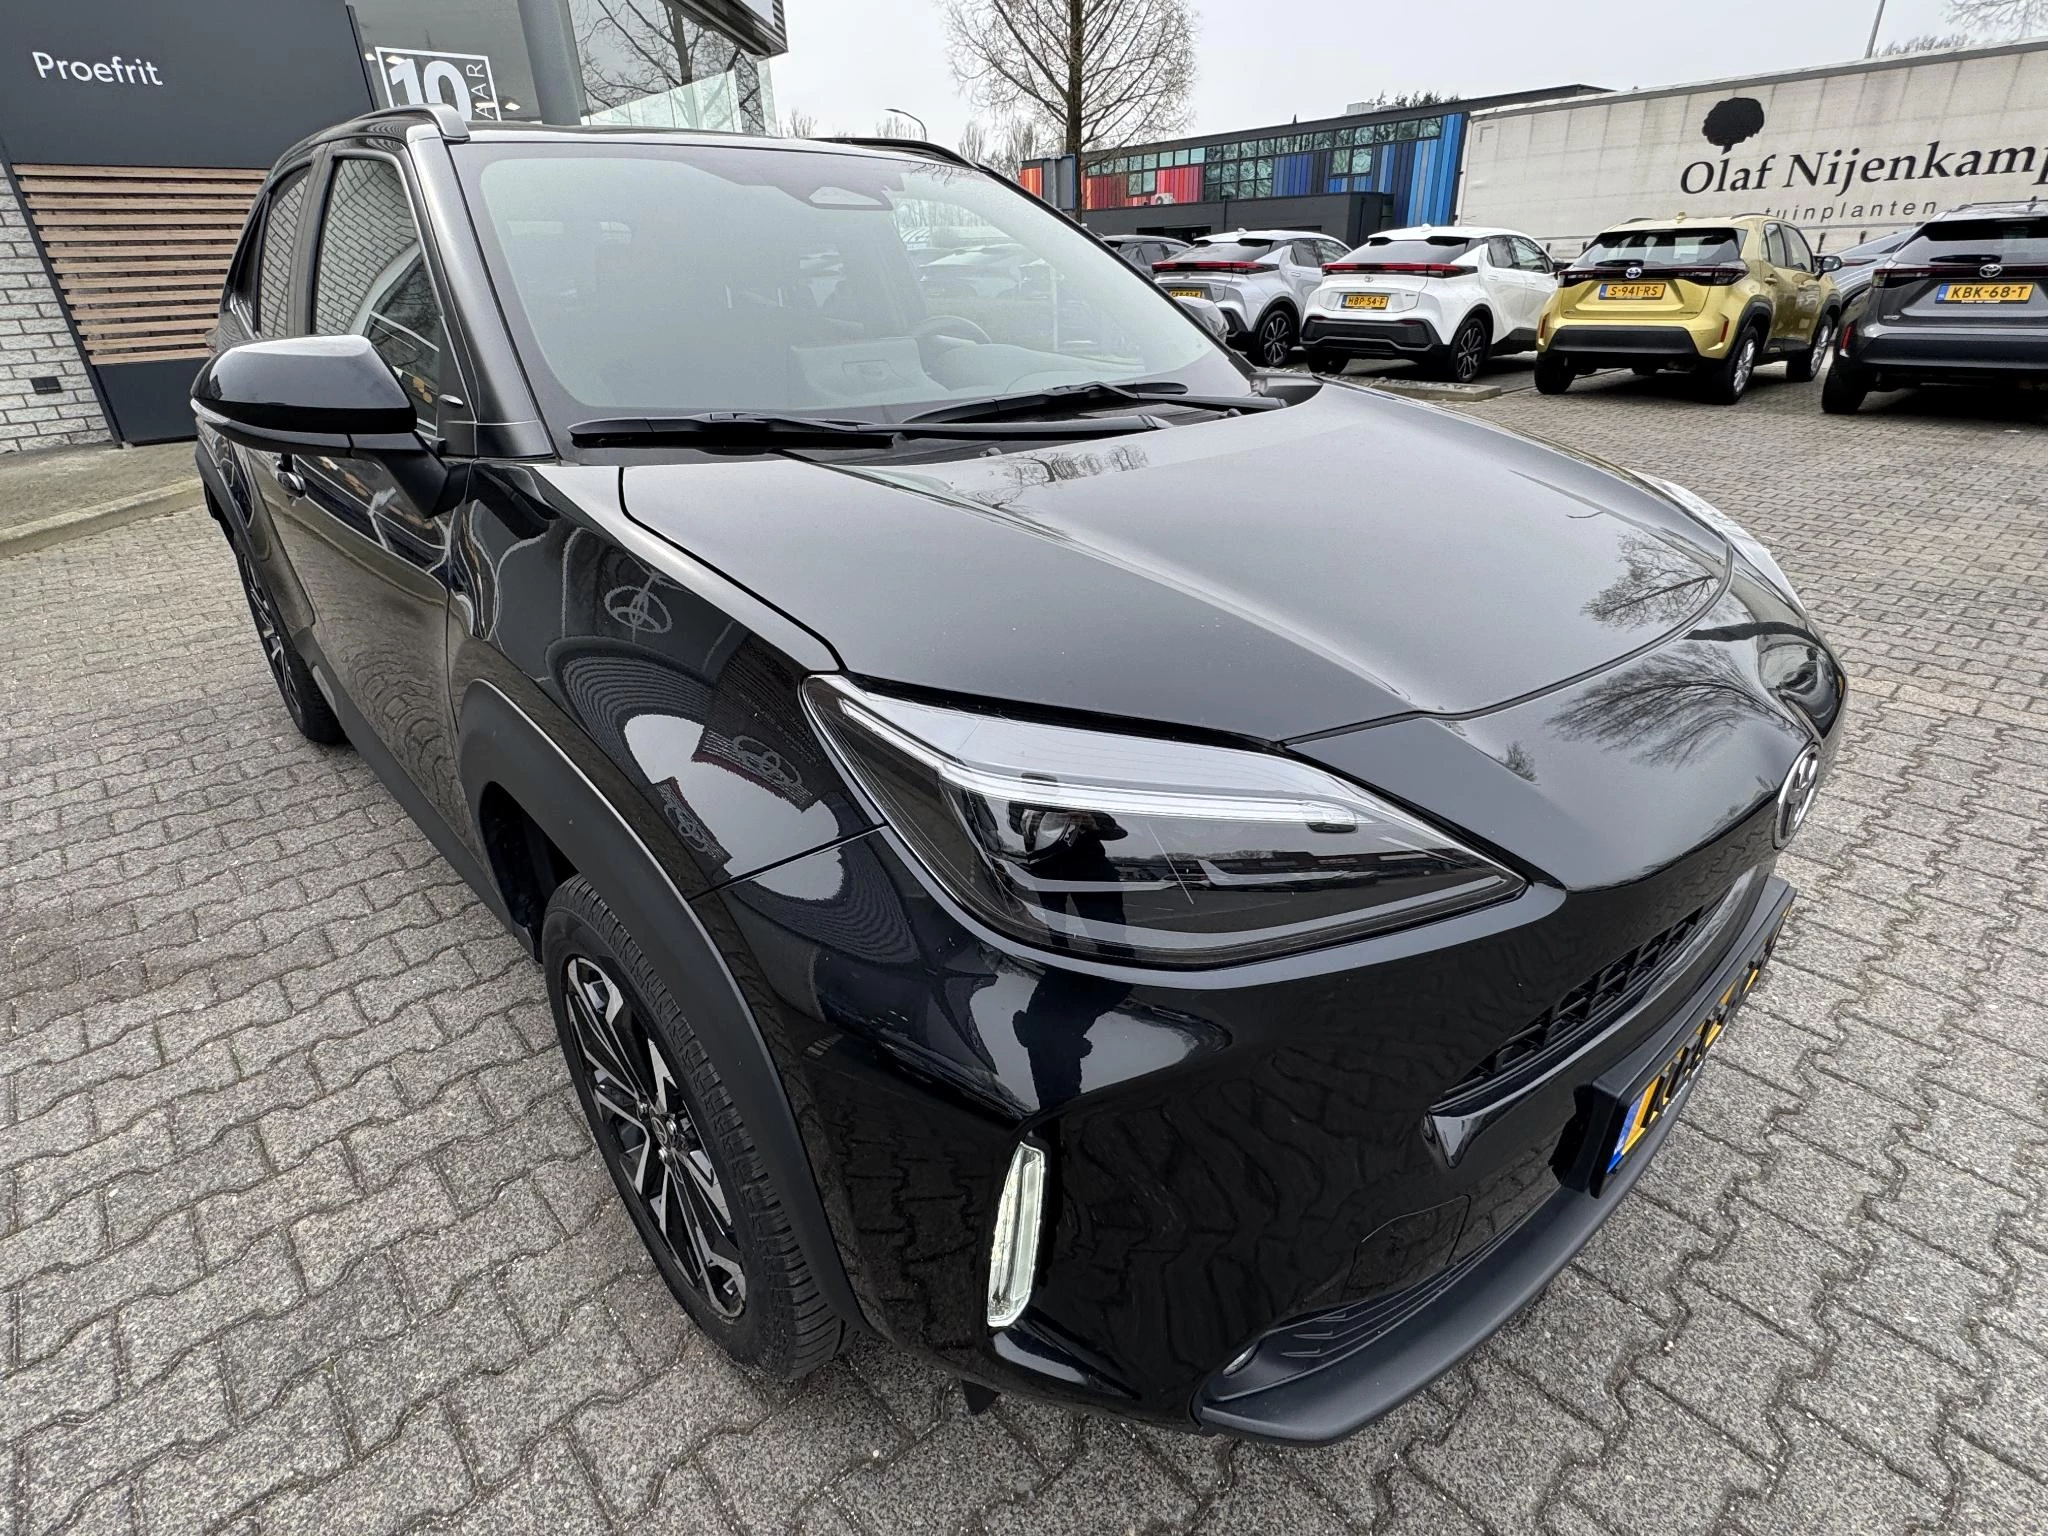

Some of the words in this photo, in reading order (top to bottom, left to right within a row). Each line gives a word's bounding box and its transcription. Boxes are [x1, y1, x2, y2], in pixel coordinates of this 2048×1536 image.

[32, 51, 163, 86] Proefrit
[389, 58, 472, 121] 10
[1680, 151, 1777, 194] Olaf
[1610, 286, 1659, 296] S-941-RS
[1950, 286, 2028, 299] KBK-68-T
